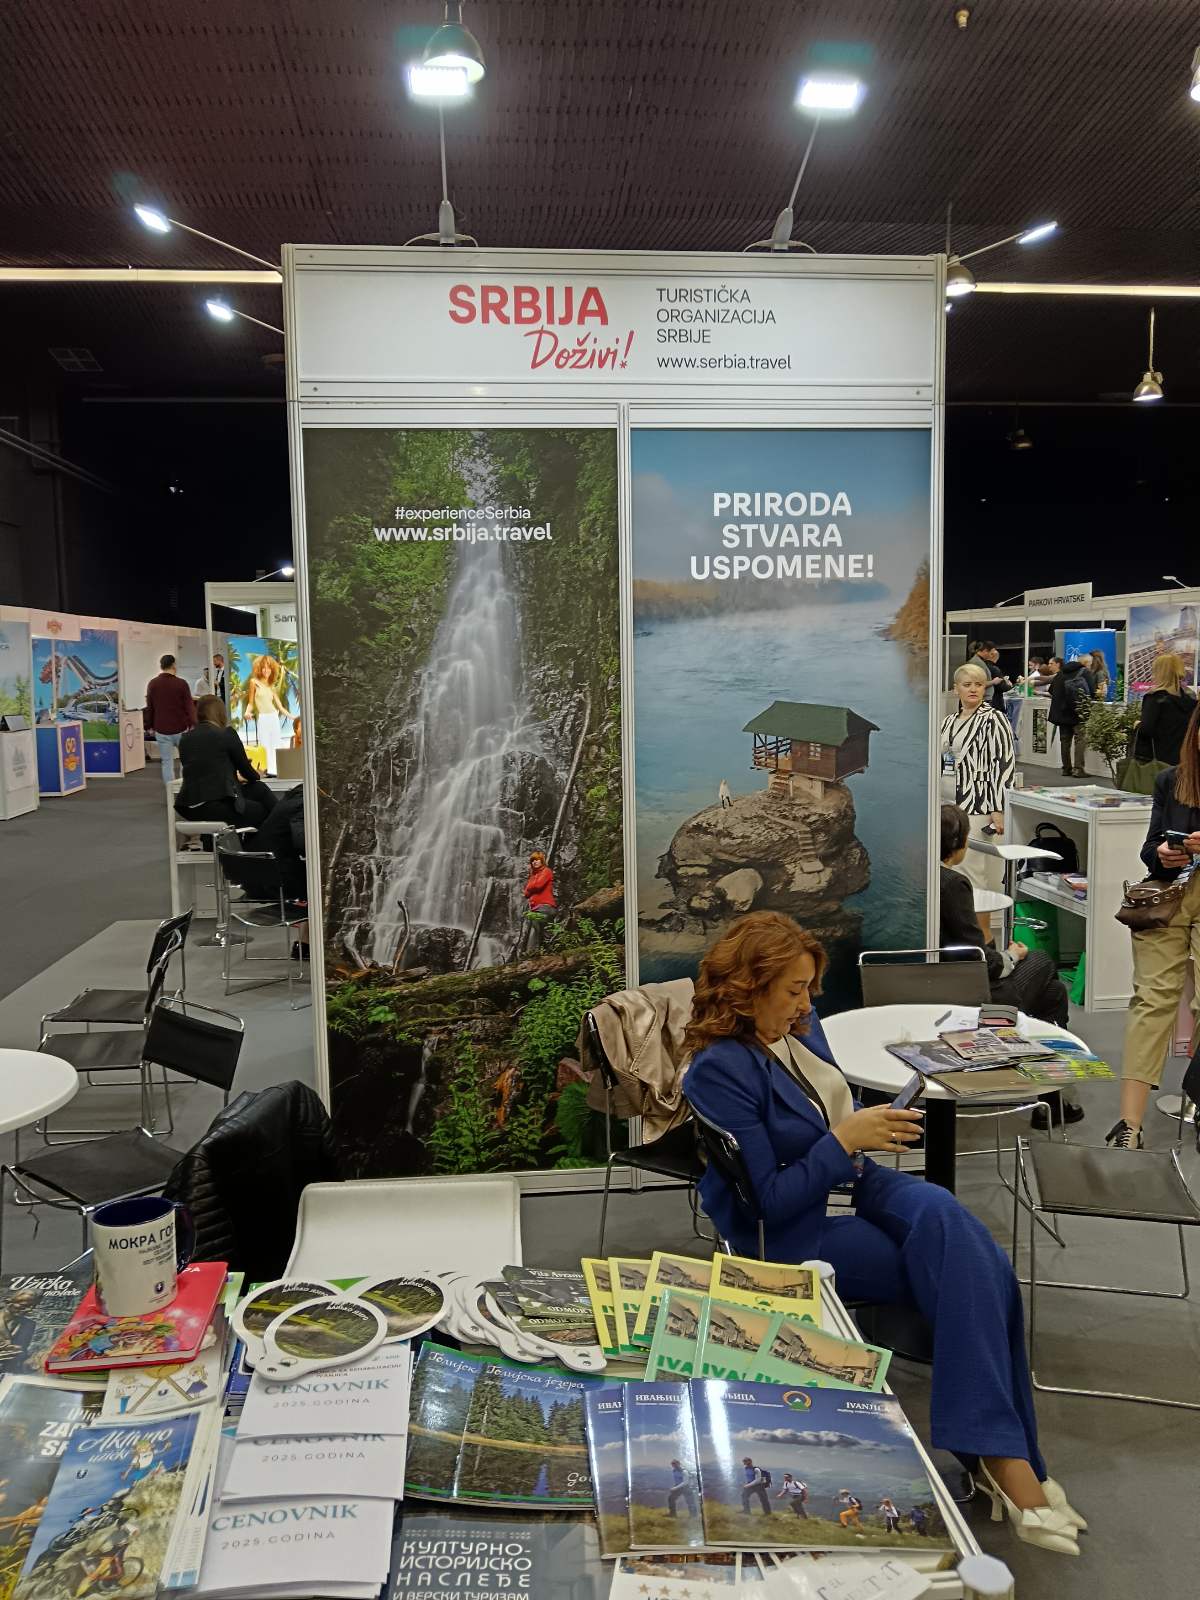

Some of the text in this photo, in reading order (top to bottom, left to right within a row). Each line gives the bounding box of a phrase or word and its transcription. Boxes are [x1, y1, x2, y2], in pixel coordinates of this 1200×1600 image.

[656, 284, 751, 304] TURISTIČKA
[449, 284, 609, 326] SRBIJA
[656, 308, 777, 325] ORGANIZACIJA
[656, 329, 712, 344] SRBIJE
[524, 325, 635, 371] Doživi!
[656, 354, 792, 370] www.serbia.travel
[713, 491, 853, 517] PRIRODA
[395, 506, 531, 522] #experienceSerbia
[374, 523, 553, 545] www.srbija.travel
[722, 523, 843, 549] STVARA
[690, 554, 875, 580] USPOMENE!
[1028, 593, 1085, 607] PARKOVI HRVATSKE
[108, 1232, 157, 1250] МОКРА
[264, 1378, 390, 1396] CENOVNIK
[211, 1503, 359, 1531] CENOVNIK
[402, 1541, 531, 1557] КУЛТУРНО-
[400, 1555, 532, 1571] ИСТОРИЈСКО
